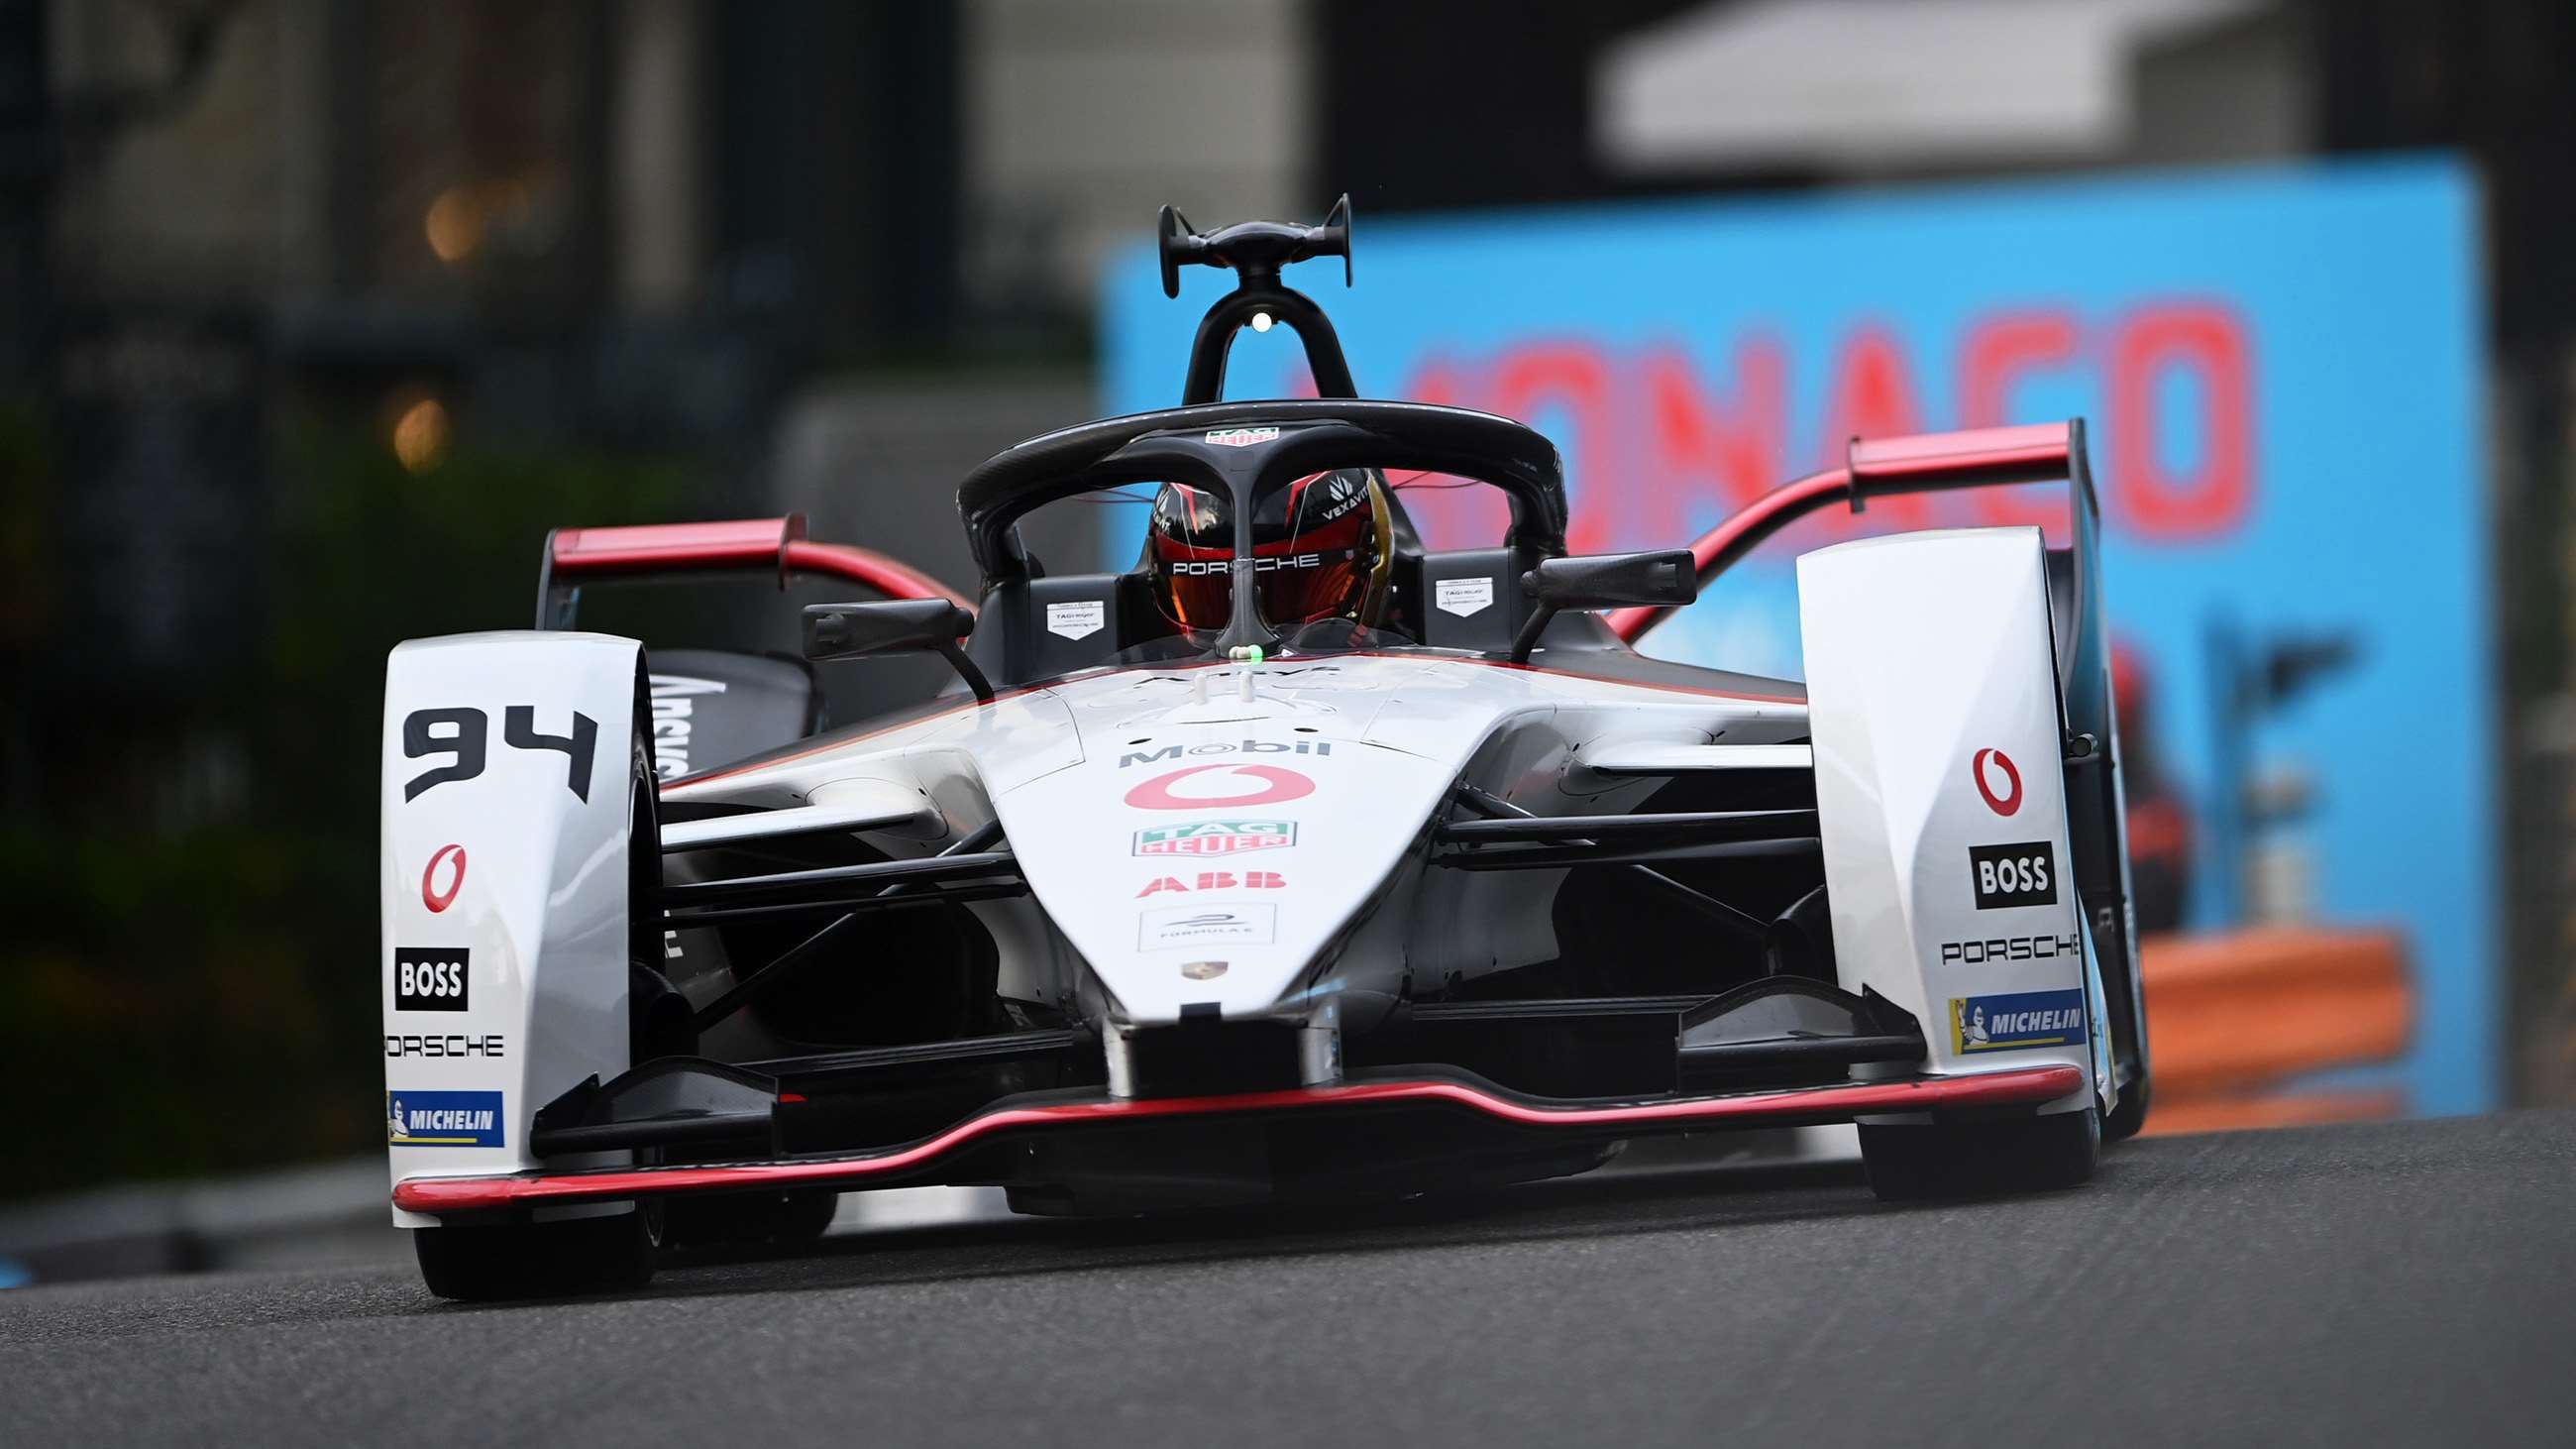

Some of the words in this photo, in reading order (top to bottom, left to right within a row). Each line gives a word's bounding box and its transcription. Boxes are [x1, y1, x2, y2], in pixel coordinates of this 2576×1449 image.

[1173, 553, 1320, 575] PORCHE
[403, 705, 597, 805] 94
[1119, 740, 1331, 768] Mobil
[1142, 835, 1287, 853] HEUER
[1145, 823, 1281, 841] TAG
[1134, 871, 1287, 899] ABB
[1979, 856, 2049, 895] BOSS
[400, 961, 462, 997] BOSS
[1990, 1008, 2082, 1035] MICHELIN
[383, 1035, 503, 1057] ORSCHE
[409, 1110, 493, 1130] MICHELIN
